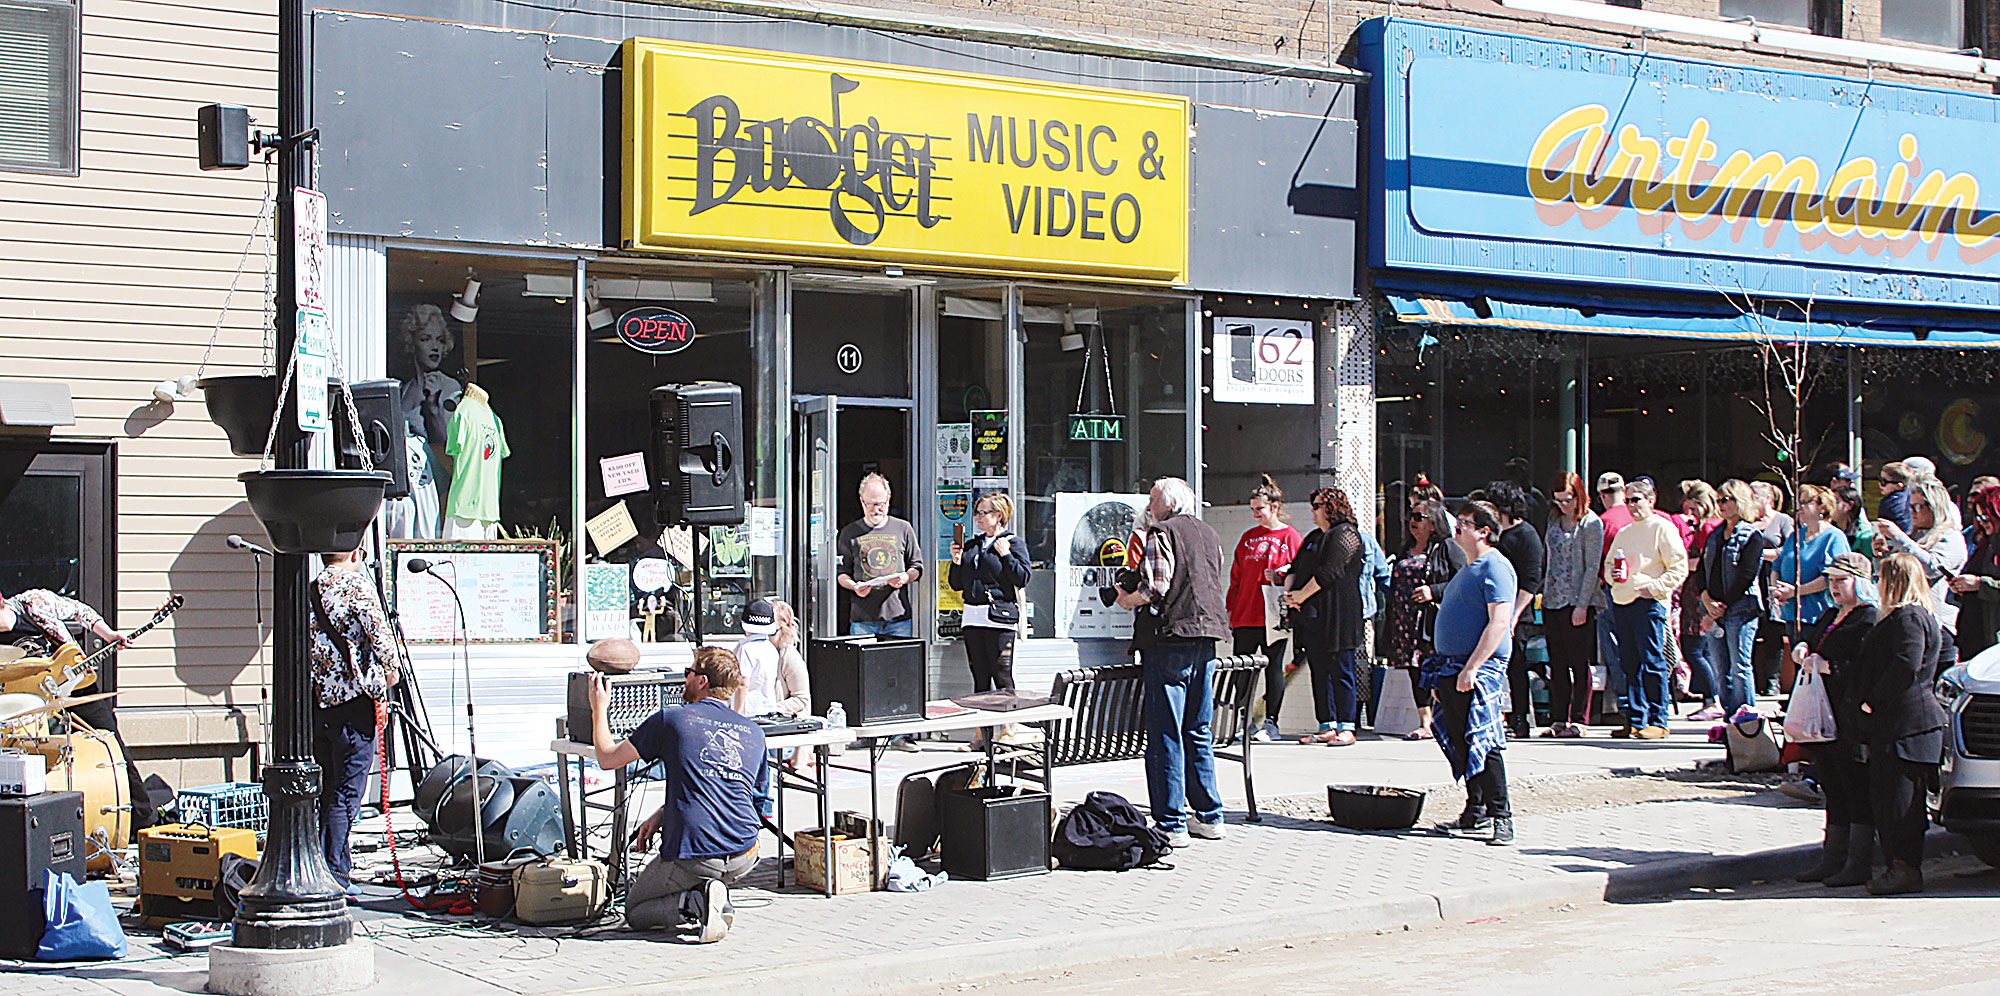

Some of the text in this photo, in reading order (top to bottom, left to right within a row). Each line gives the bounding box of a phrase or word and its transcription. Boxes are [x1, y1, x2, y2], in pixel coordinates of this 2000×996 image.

[967, 112, 1166, 180] MUSIC &
[686, 73, 941, 245] Budget
[1001, 183, 1142, 244] VIDEO
[624, 317, 688, 342] OPEN
[1259, 327, 1303, 365] 62
[841, 350, 857, 367] 11
[1259, 367, 1304, 383] DOORS
[1074, 418, 1121, 440] ATM
[592, 613, 625, 622] WILD
[592, 623, 626, 631] HANDS
[713, 720, 732, 729] PLAY
